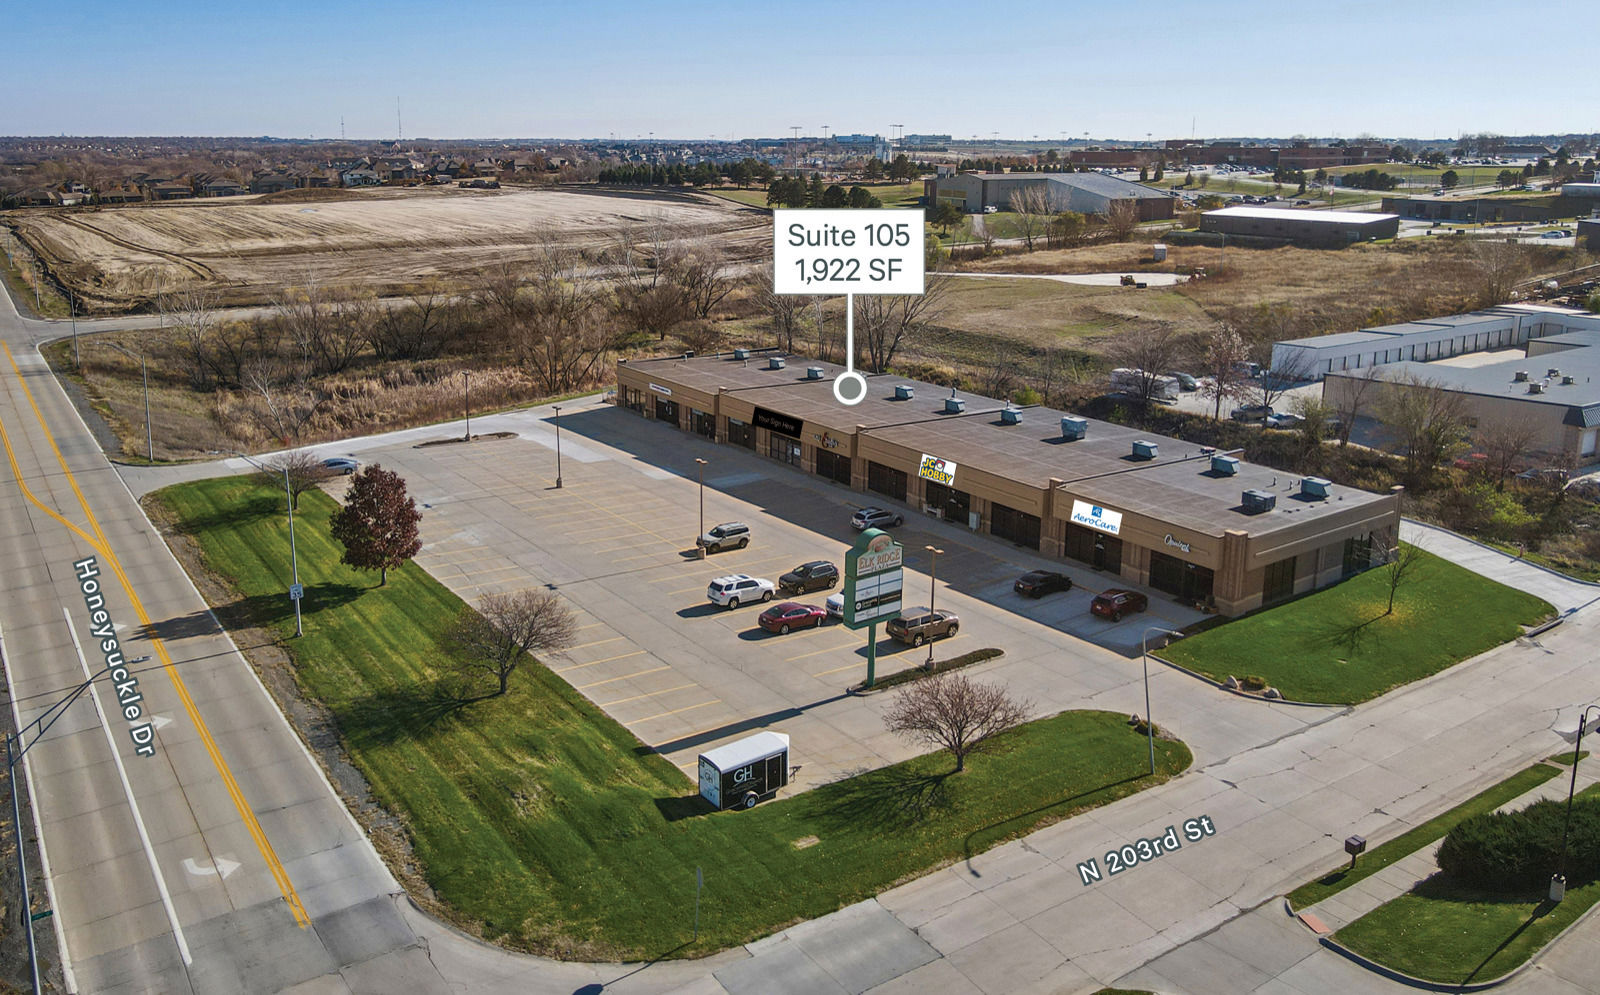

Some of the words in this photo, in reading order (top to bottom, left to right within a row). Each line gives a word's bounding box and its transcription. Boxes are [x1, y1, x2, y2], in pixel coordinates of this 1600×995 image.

[758, 414, 770, 423] Your
[770, 417, 782, 428] Sign
[782, 421, 795, 431] Here
[922, 457, 936, 469] JC
[920, 467, 954, 484] HOBBY
[1073, 512, 1118, 531] AeroCare
[858, 555, 876, 569] ELK
[876, 547, 901, 565] RIDGE
[733, 764, 753, 783] GH
